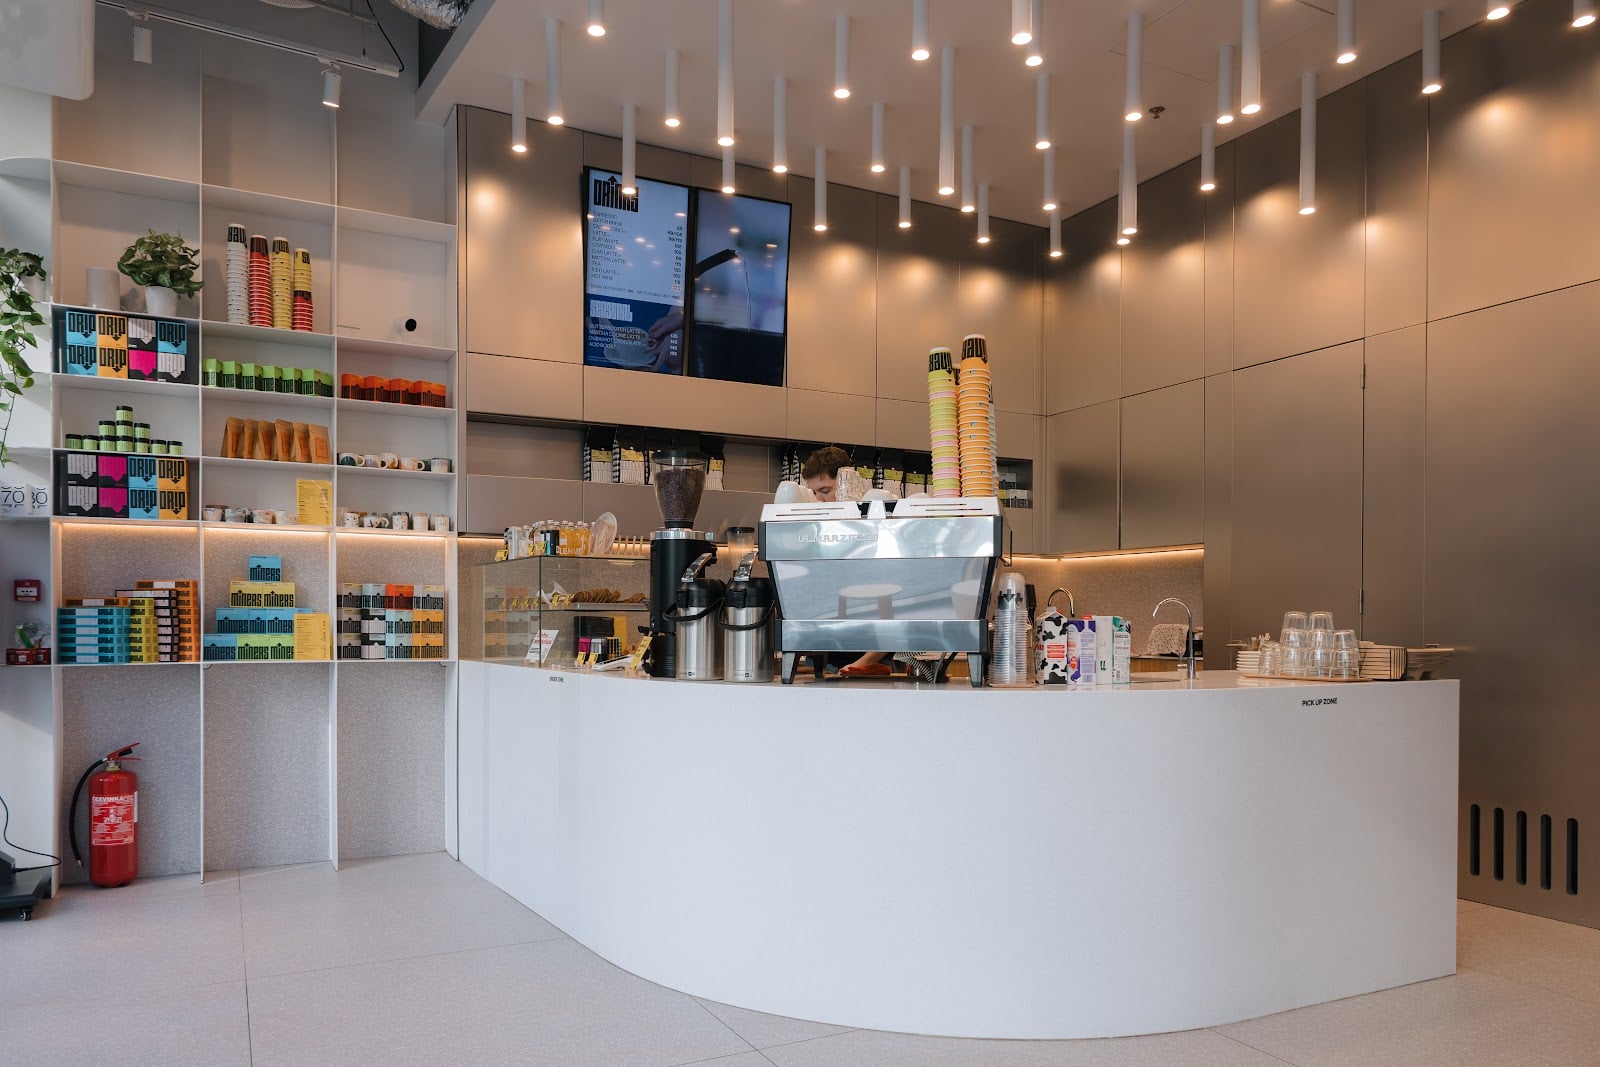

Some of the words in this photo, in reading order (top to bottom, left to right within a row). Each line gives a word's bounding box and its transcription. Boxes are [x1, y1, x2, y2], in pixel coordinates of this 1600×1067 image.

[69, 313, 96, 338] DRIP
[98, 315, 126, 341] DRIP
[159, 322, 185, 347] DRIP
[69, 344, 96, 370] DRIP
[99, 347, 126, 373] DRIP
[130, 489, 157, 514] DRIP
[159, 490, 186, 515] DRIP
[1301, 699, 1315, 707] PICK
[1315, 698, 1323, 706] UP
[1323, 697, 1338, 705] ZONE
